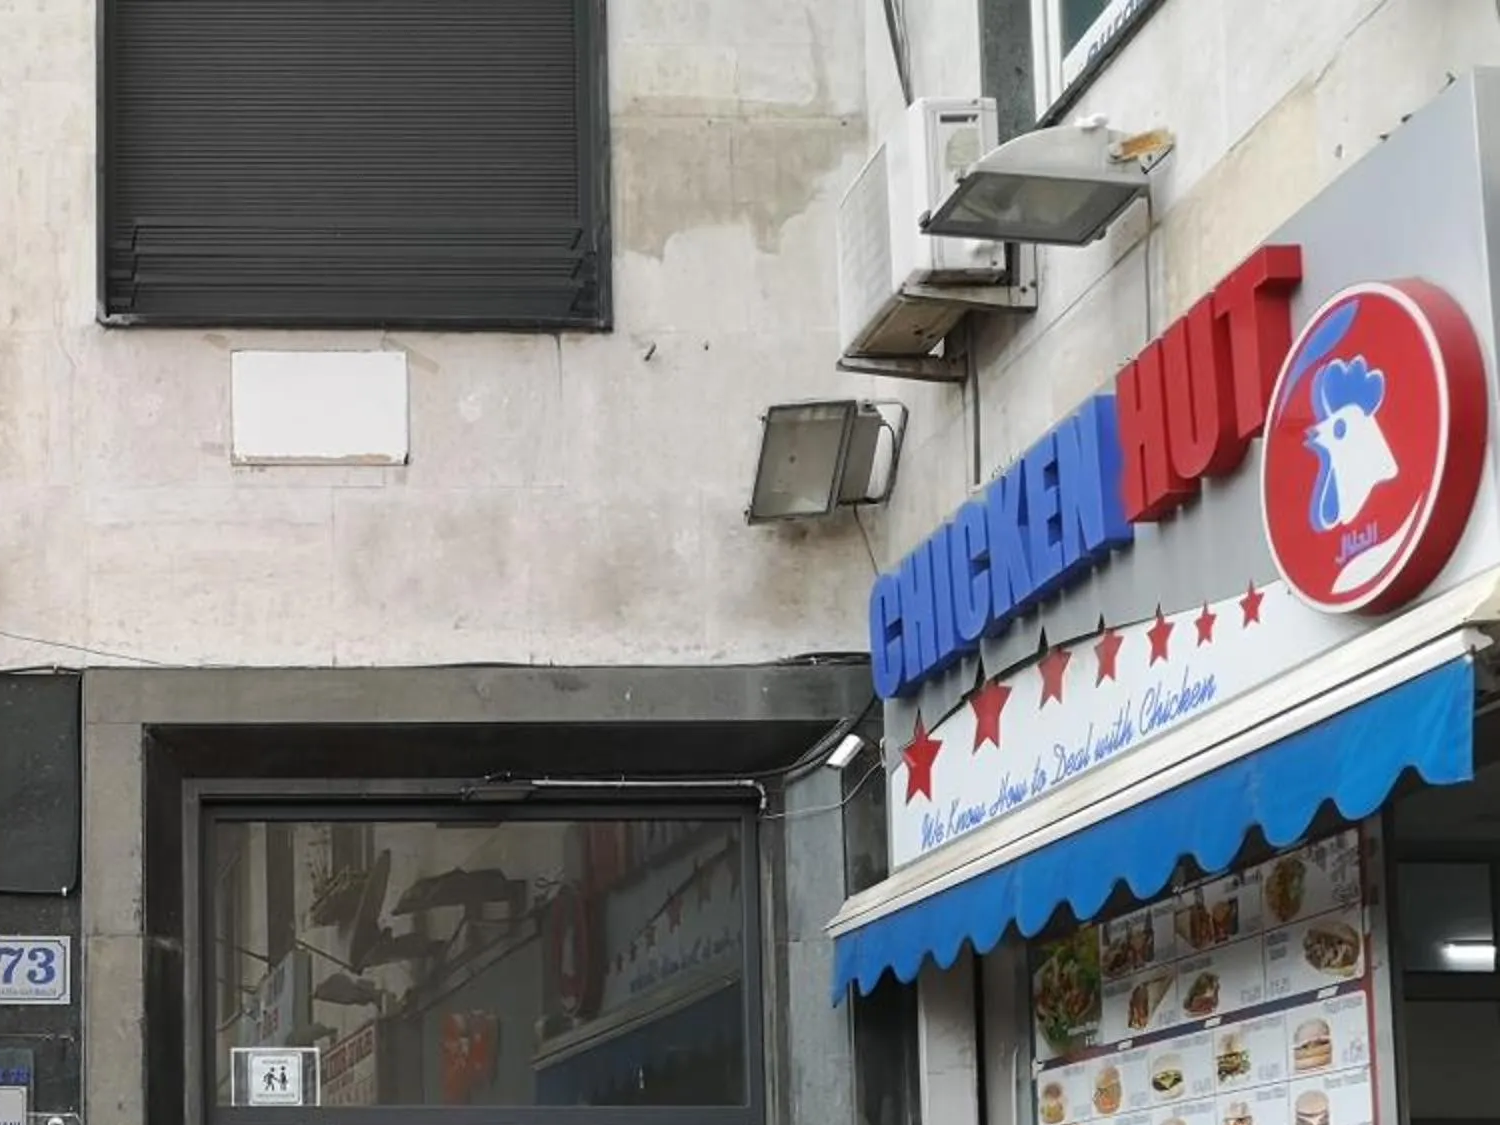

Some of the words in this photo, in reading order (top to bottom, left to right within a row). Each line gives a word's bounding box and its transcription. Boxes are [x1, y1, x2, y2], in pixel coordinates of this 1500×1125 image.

[870, 393, 1134, 700] CHICKEN
[1115, 244, 1302, 524] HUT
[920, 807, 946, 850] We
[945, 798, 987, 837] Know
[988, 771, 1029, 818] How
[1030, 755, 1048, 793] to
[1049, 722, 1093, 786] Deal
[1093, 699, 1136, 763] with
[1138, 664, 1218, 737] Chicken
